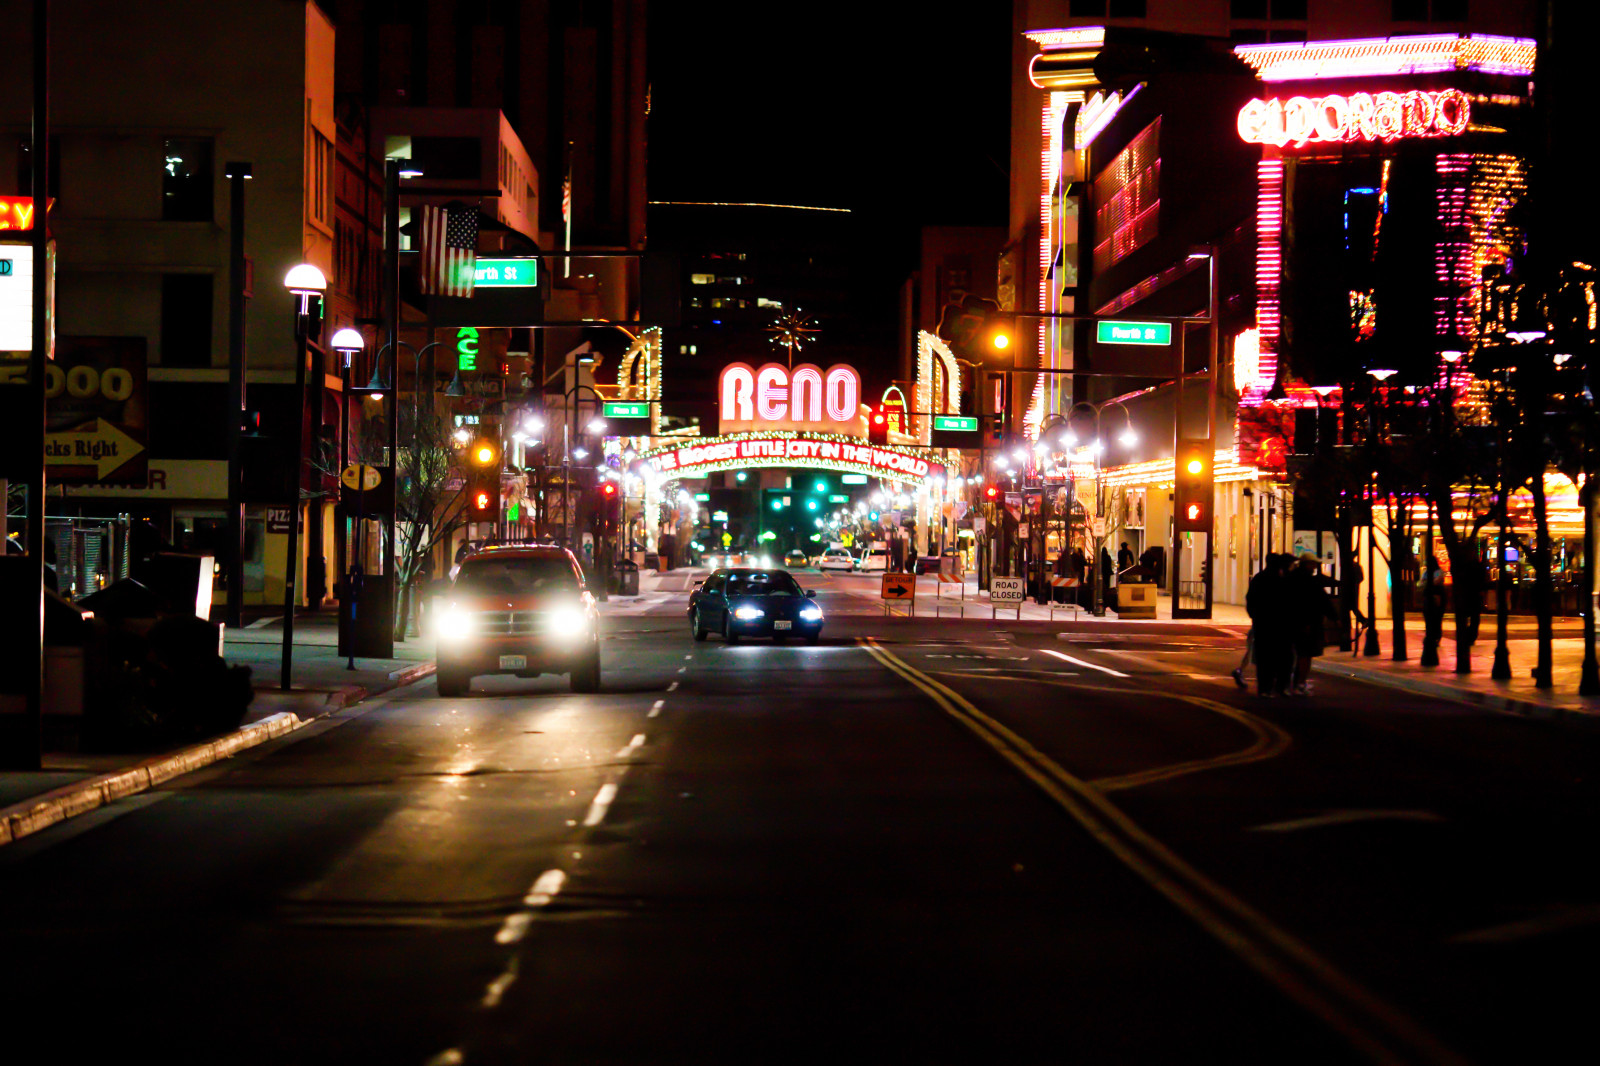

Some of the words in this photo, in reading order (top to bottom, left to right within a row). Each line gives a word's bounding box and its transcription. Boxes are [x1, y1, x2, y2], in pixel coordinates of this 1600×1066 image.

[465, 266, 499, 280] urth
[504, 266, 518, 280] St
[1145, 328, 1156, 339] St
[722, 366, 857, 422] RENO
[74, 440, 118, 460] Right
[649, 453, 676, 471] THE
[678, 442, 738, 466] BIGGEST
[741, 440, 785, 457] LITTLE
[789, 440, 821, 457] CITY
[821, 442, 839, 459] IN
[842, 444, 870, 463] THE
[873, 449, 929, 476] WORLD
[995, 581, 1018, 589] ROAD
[991, 591, 1022, 599] CLOSED
